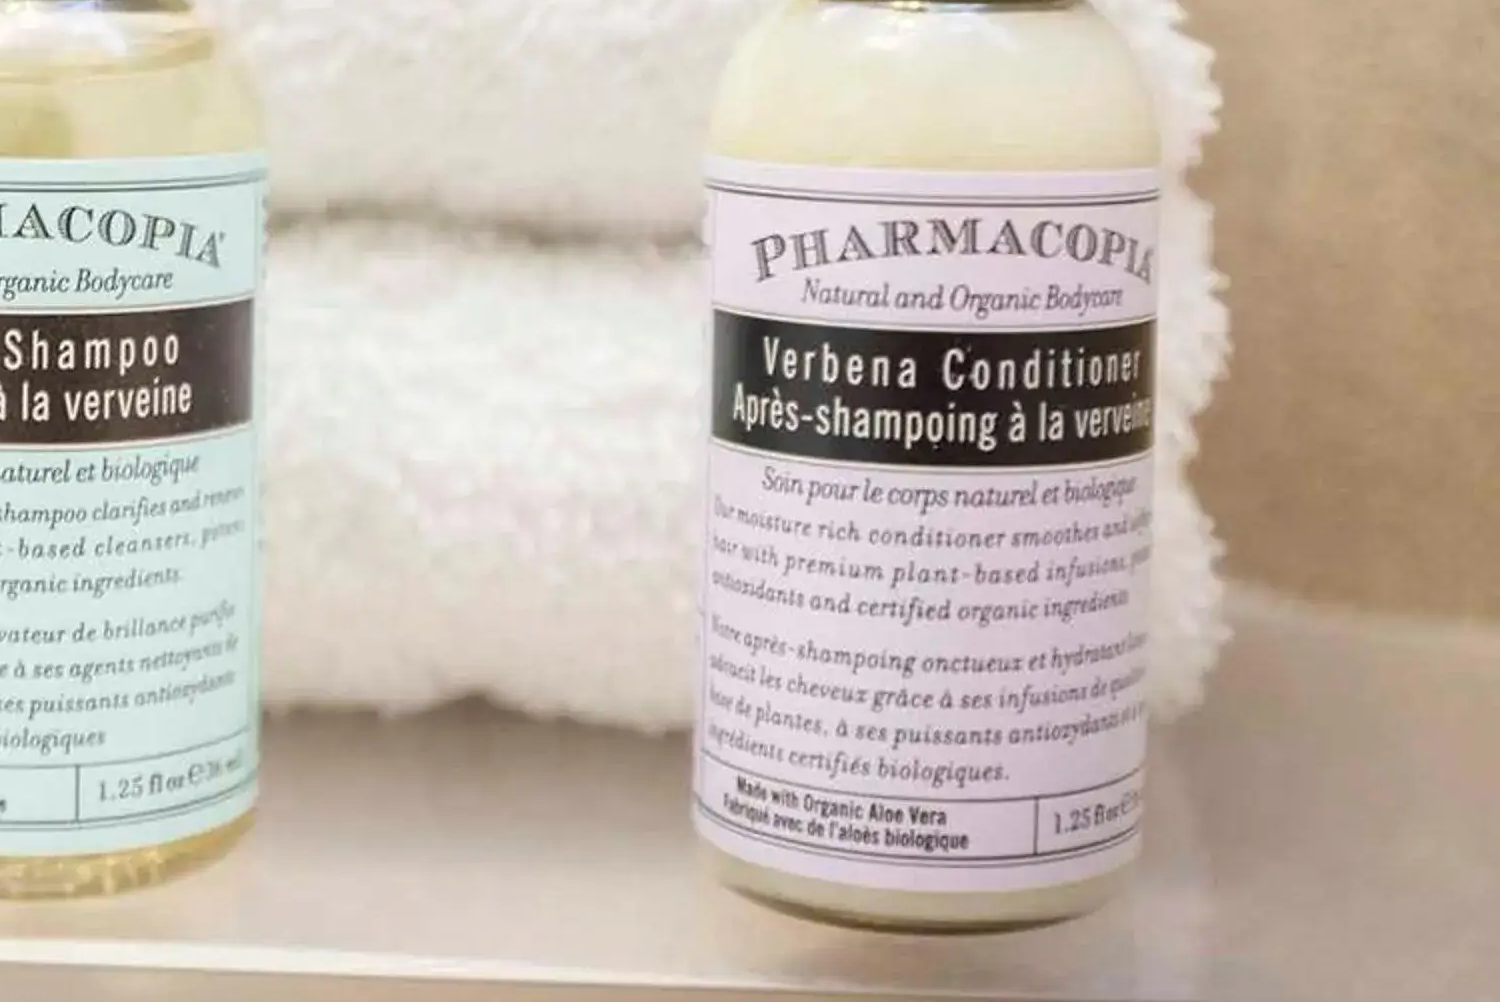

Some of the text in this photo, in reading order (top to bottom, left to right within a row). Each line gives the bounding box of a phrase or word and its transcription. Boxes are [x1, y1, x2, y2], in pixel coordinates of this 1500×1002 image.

[750, 217, 1153, 286] PHARMACOPIA
[75, 268, 174, 300] Bodycare
[801, 277, 1124, 319] Natural and Organic Bodycare
[3, 328, 180, 377] Shampoo
[762, 335, 1141, 392] Verbena Conditioner
[21, 380, 50, 422] la
[64, 374, 194, 422] verveine
[733, 381, 998, 452] Après-shampoing
[1009, 401, 1026, 443] à
[1038, 401, 1065, 442] la
[75, 462, 96, 484] et
[101, 454, 200, 487] biologique
[761, 465, 804, 497] Soin
[805, 480, 860, 506] pour
[862, 477, 884, 504] le
[887, 487, 949, 516] corps
[953, 476, 1039, 509] naturel
[1041, 484, 1060, 508] et
[91, 496, 167, 527] clarifies
[170, 489, 200, 514] and
[737, 506, 814, 537] moisture
[816, 518, 861, 543] rich
[868, 524, 1007, 549] conditioner
[1009, 521, 1100, 549] smoothes
[741, 543, 780, 569] with
[782, 552, 885, 581] premium
[889, 559, 1040, 590] plant-based
[809, 591, 852, 615] and
[856, 595, 950, 628] certified
[956, 604, 1040, 629] organic
[71, 621, 97, 644] de
[103, 617, 187, 641] brillance
[13, 658, 26, 679] à
[32, 662, 64, 680] ses
[68, 655, 135, 685] agents
[742, 630, 917, 679] après-shampoing
[920, 652, 1023, 675] onctueux
[1027, 651, 1046, 672] et
[28, 692, 129, 721] puissants
[785, 671, 868, 705] cheveux
[870, 688, 934, 715] grâce
[938, 687, 953, 711] à
[959, 692, 993, 711] ses
[835, 717, 849, 739] à
[854, 726, 887, 743] ses
[890, 723, 1003, 750] puissants
[787, 749, 871, 782] certifiés
[98, 776, 144, 803] 1.25
[148, 773, 163, 796] fl
[770, 788, 800, 808] with
[802, 793, 864, 820] Organic
[868, 802, 904, 823] Aloe
[908, 805, 948, 826] Vera
[772, 811, 803, 833] avec
[806, 817, 826, 838] de
[884, 829, 970, 853] biologique
[1053, 807, 1092, 835] 1.25
